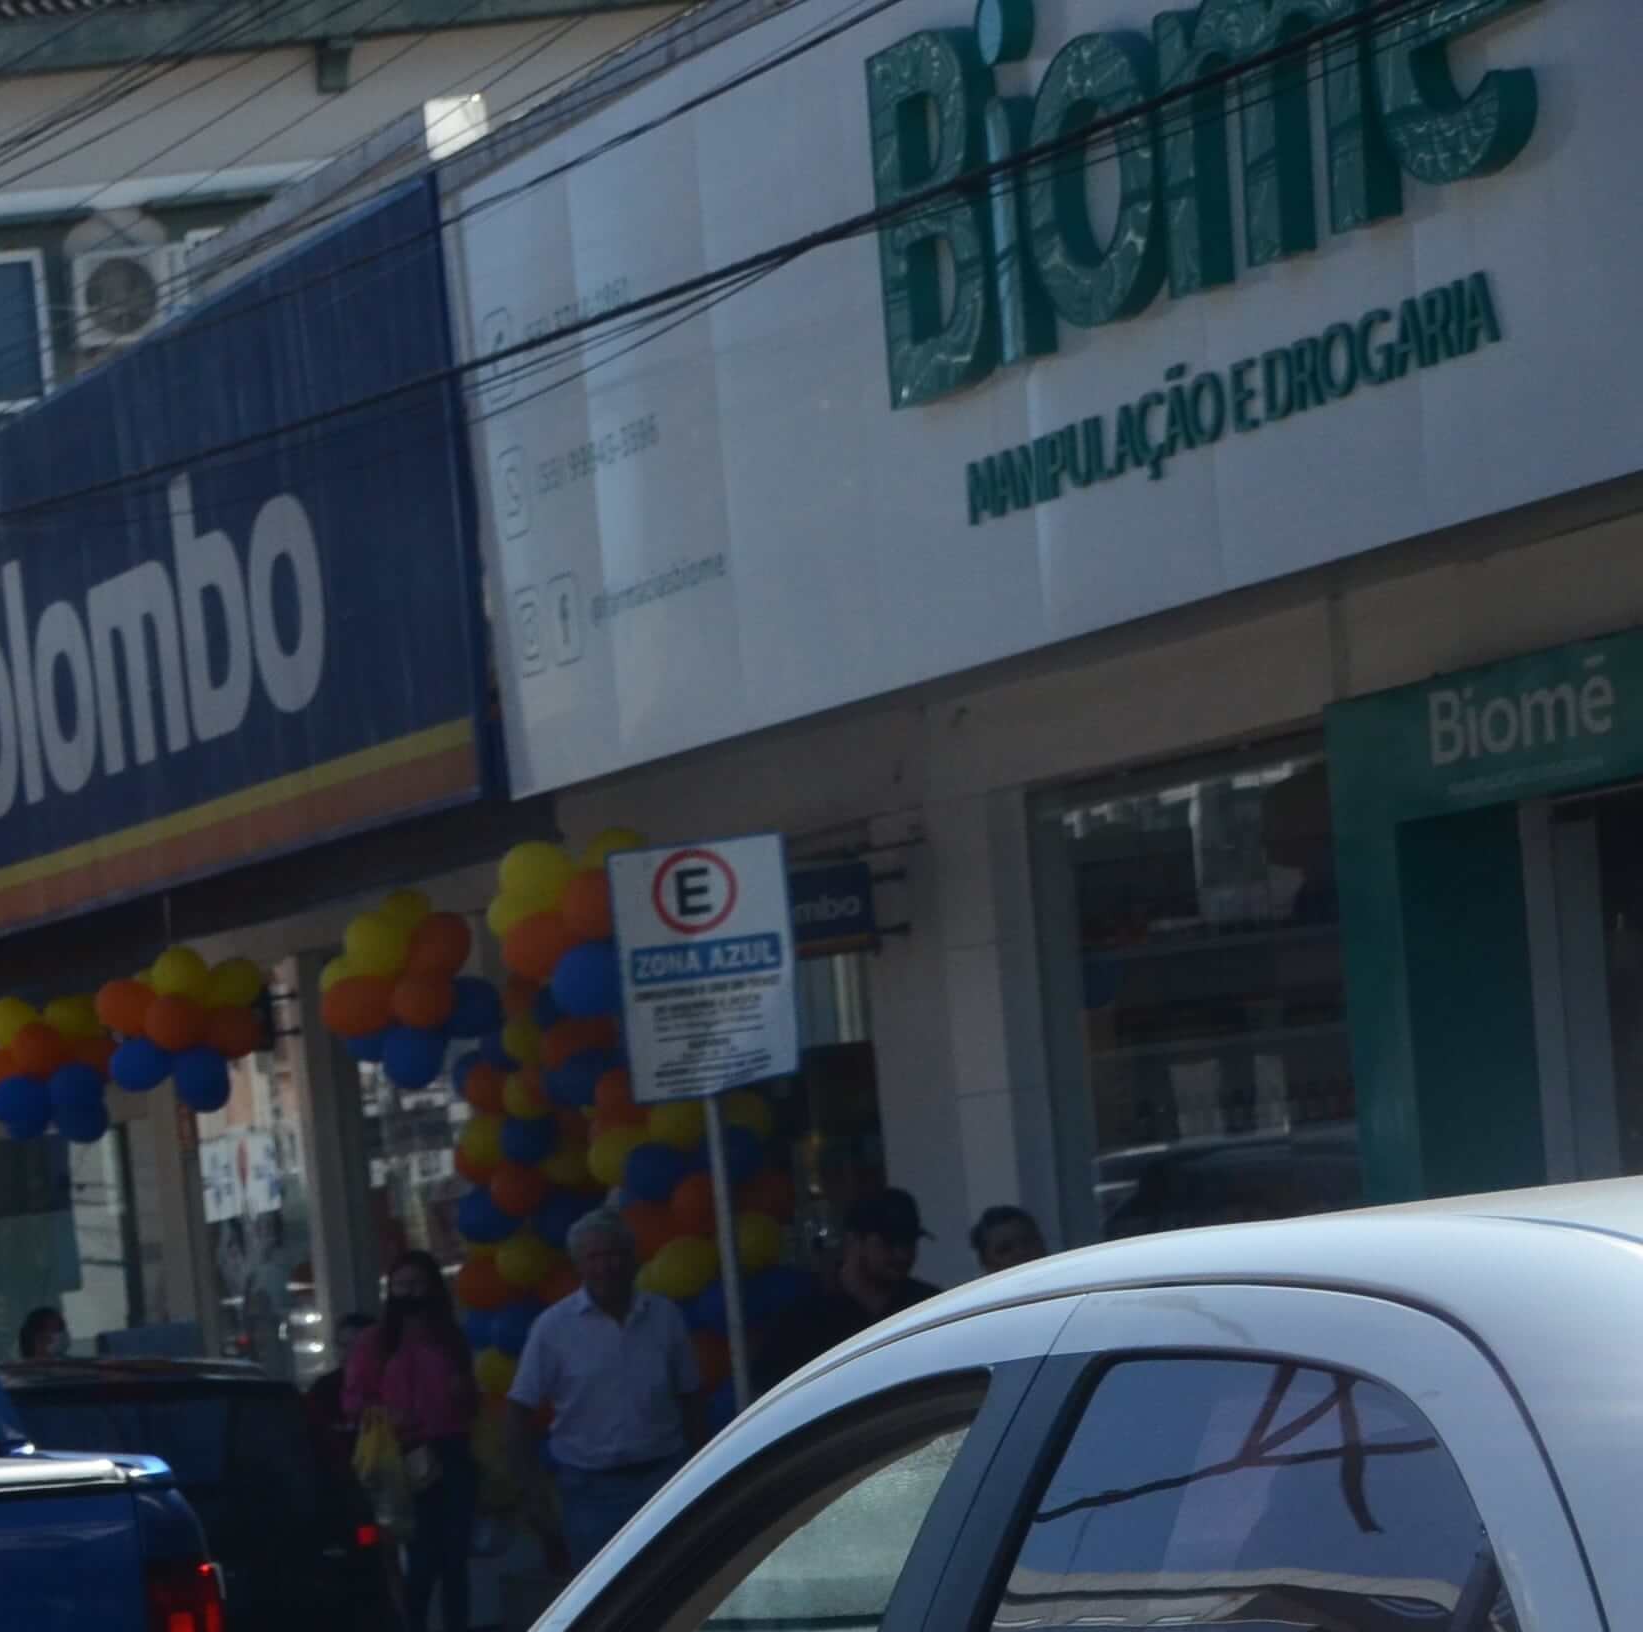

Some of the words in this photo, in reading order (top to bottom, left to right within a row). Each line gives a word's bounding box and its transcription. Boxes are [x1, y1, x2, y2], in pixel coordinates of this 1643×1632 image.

[965, 363, 1227, 526] MANIPULAÇÃO
[1229, 357, 1261, 434] E
[1261, 270, 1502, 422] DROGARIA
[674, 866, 713, 917] E
[635, 949, 703, 979] ZONA
[709, 938, 779, 971] AZUL
